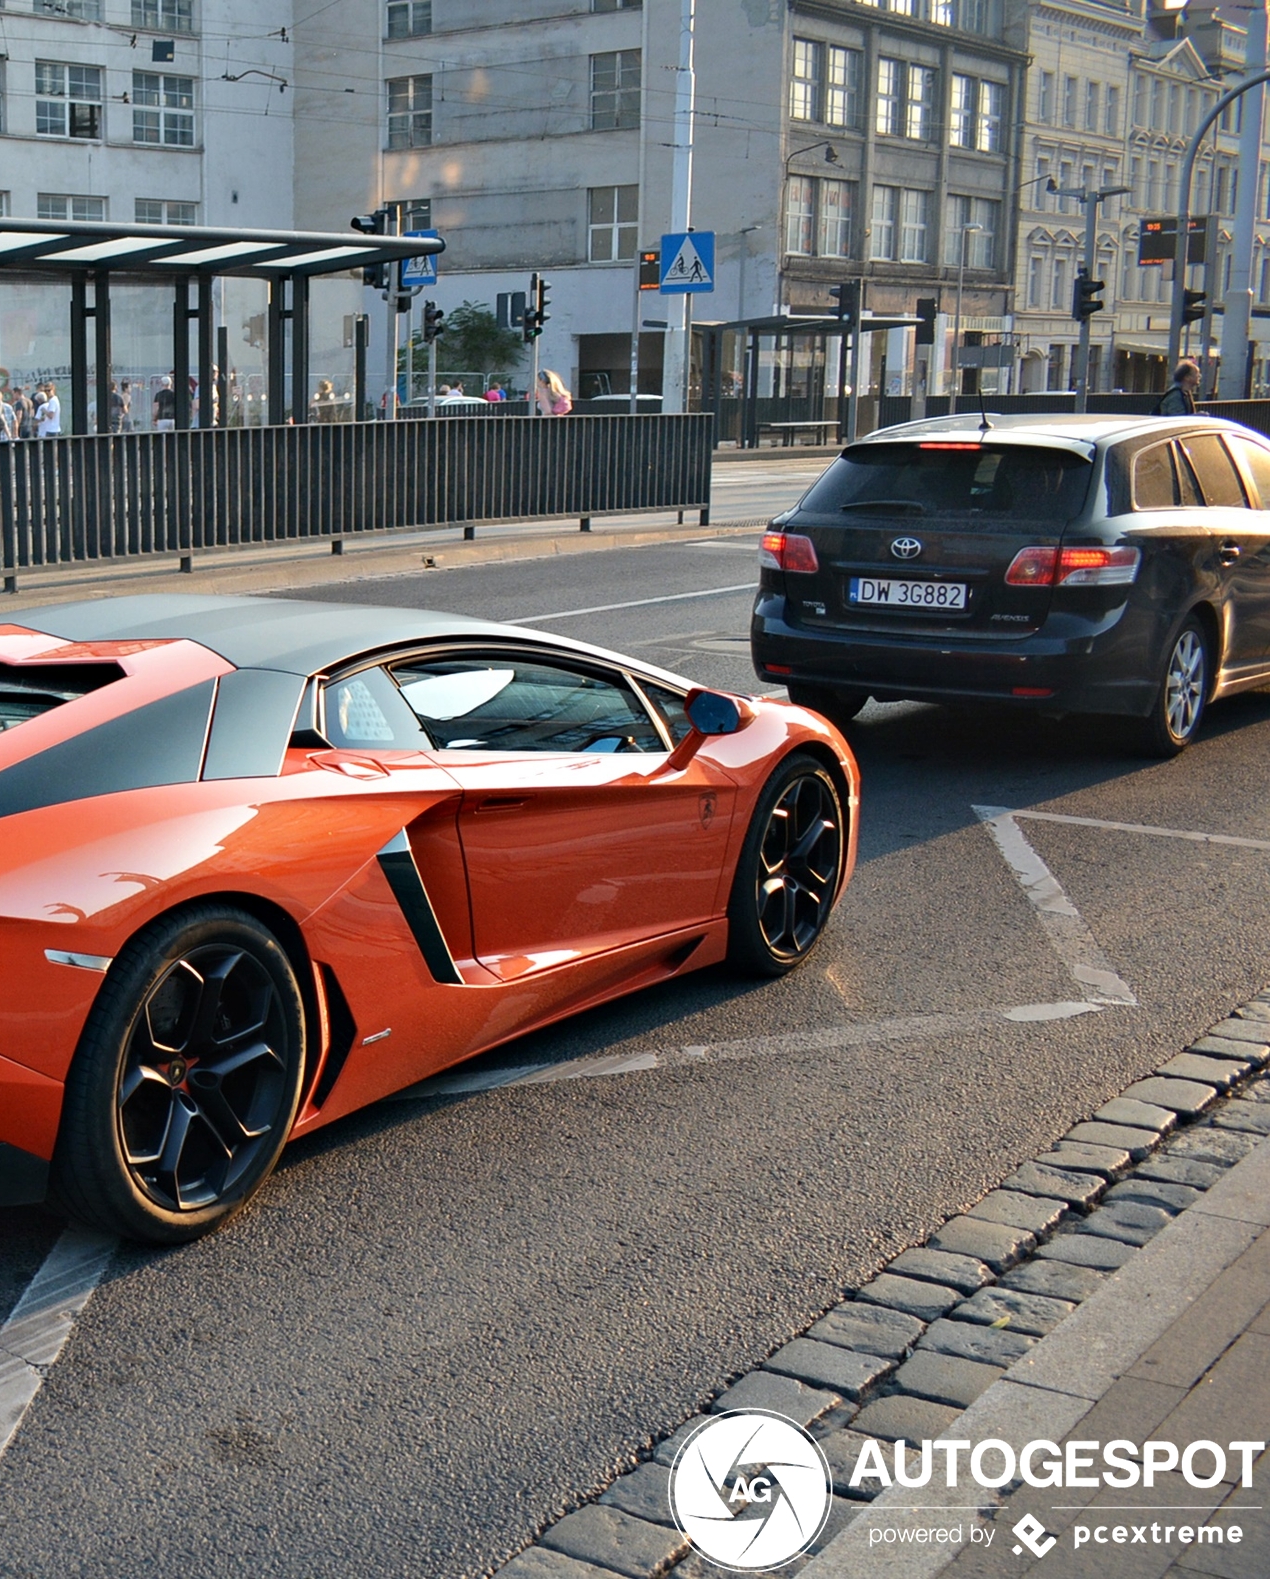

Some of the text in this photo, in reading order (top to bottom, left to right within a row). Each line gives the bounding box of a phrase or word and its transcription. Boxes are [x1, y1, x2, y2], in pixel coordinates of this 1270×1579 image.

[862, 580, 890, 602] DW
[898, 583, 962, 606] 3G882
[802, 600, 825, 608] TOYOTA
[990, 613, 1030, 622] AVENSIS
